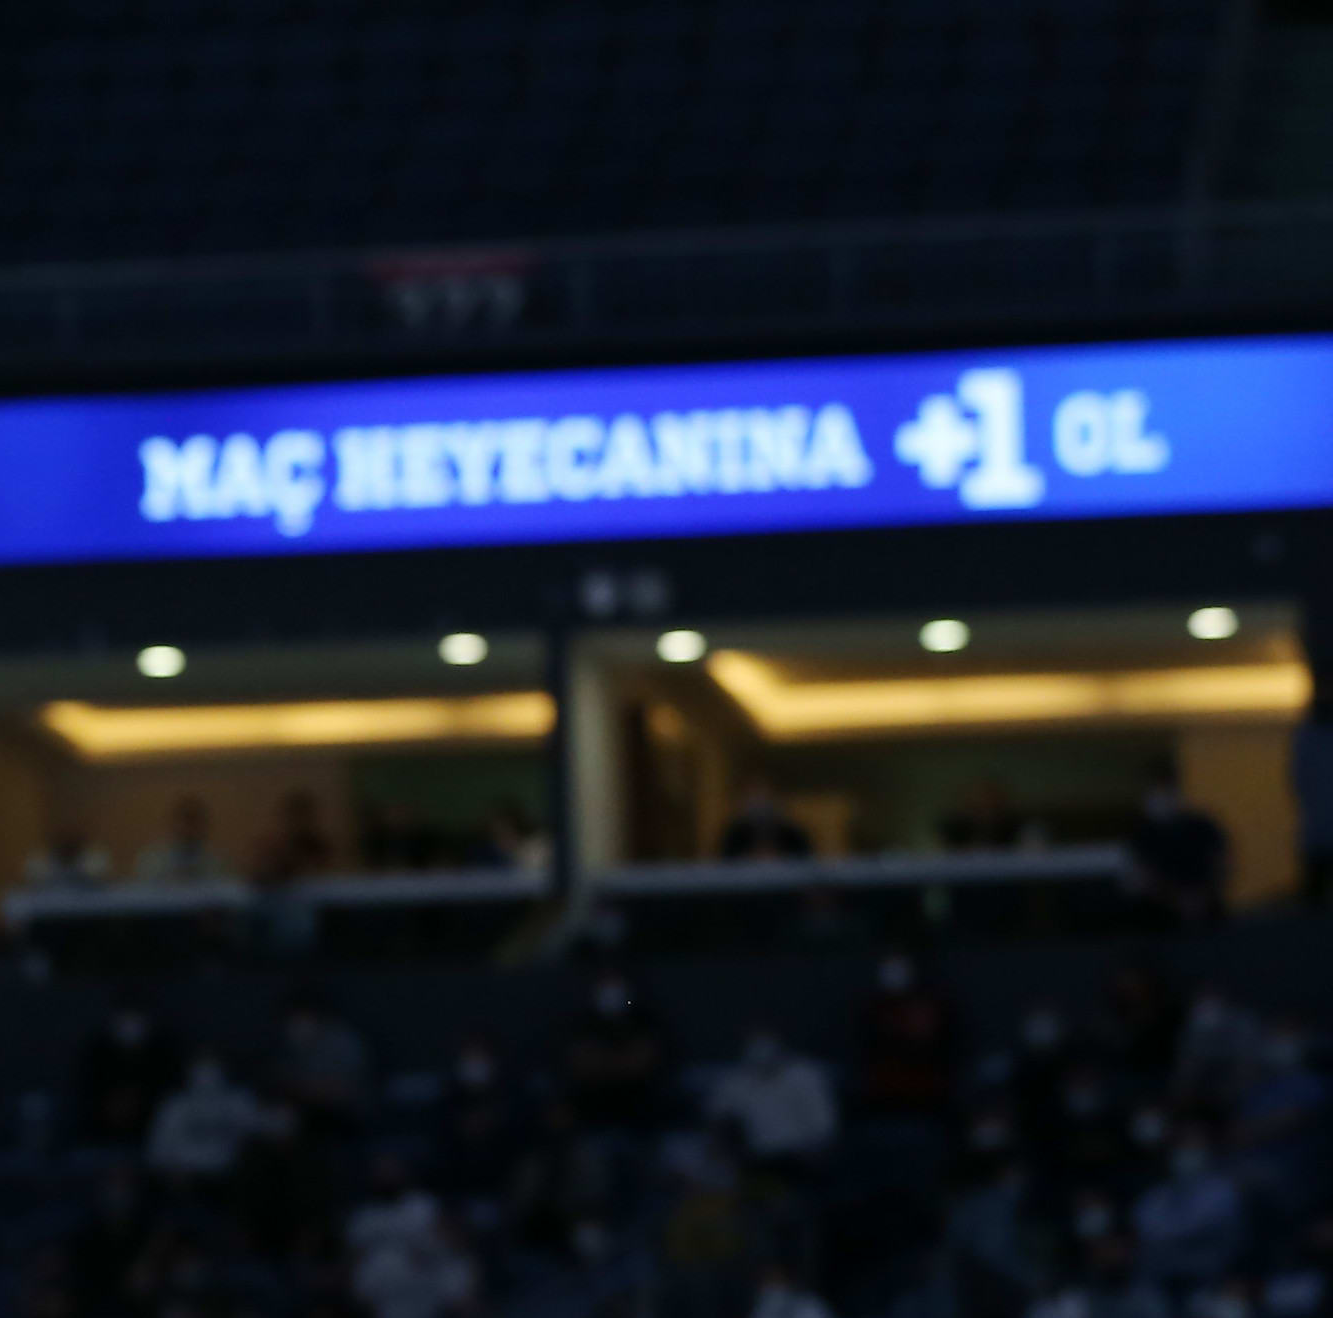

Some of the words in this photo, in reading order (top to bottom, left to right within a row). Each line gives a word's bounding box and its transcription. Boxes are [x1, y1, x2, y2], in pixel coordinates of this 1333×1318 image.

[140, 430, 326, 535] MAÇ
[333, 406, 873, 509] HEYECANINA
[895, 366, 1045, 510] +1
[1054, 388, 1169, 477] OL
